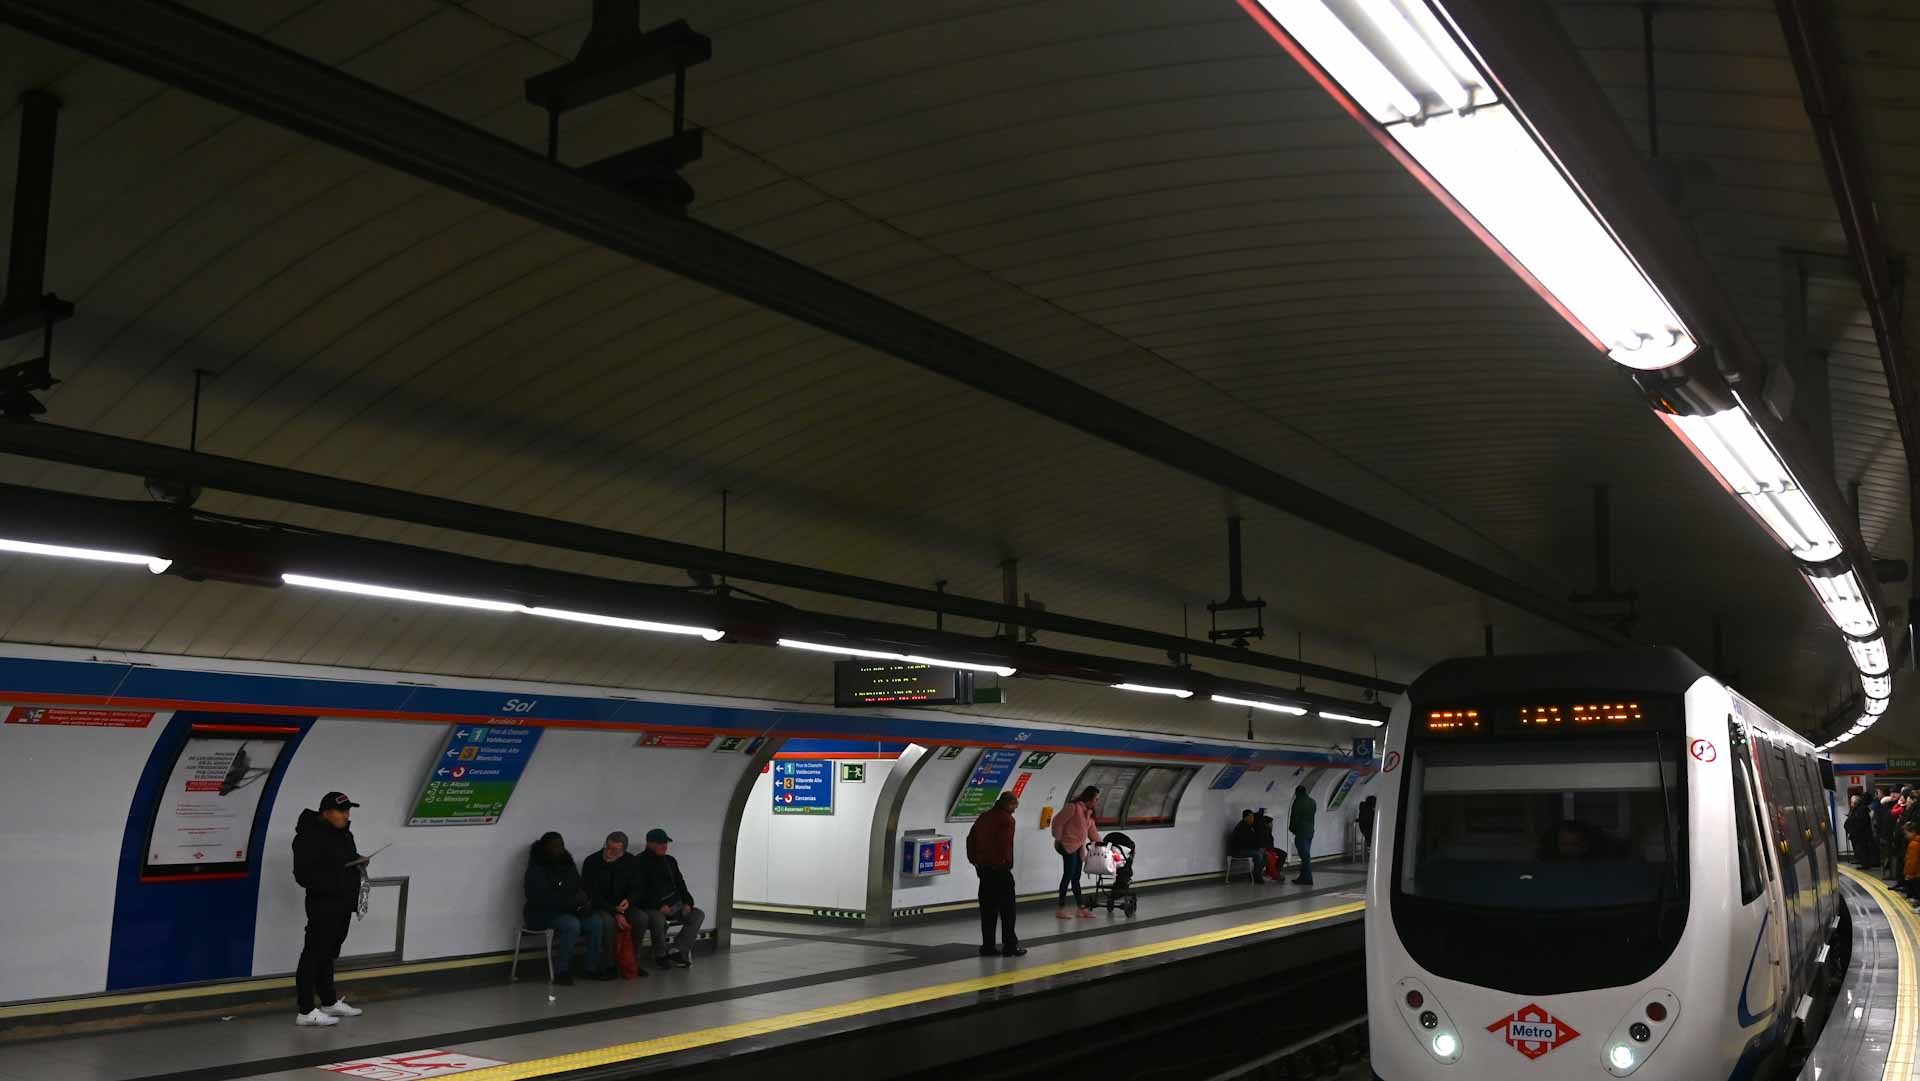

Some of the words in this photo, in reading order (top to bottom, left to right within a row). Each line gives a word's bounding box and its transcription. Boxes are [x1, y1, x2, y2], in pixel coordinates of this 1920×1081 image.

[502, 699, 537, 713] Sol
[785, 778, 792, 789] 3
[1512, 1024, 1553, 1038] Metro
